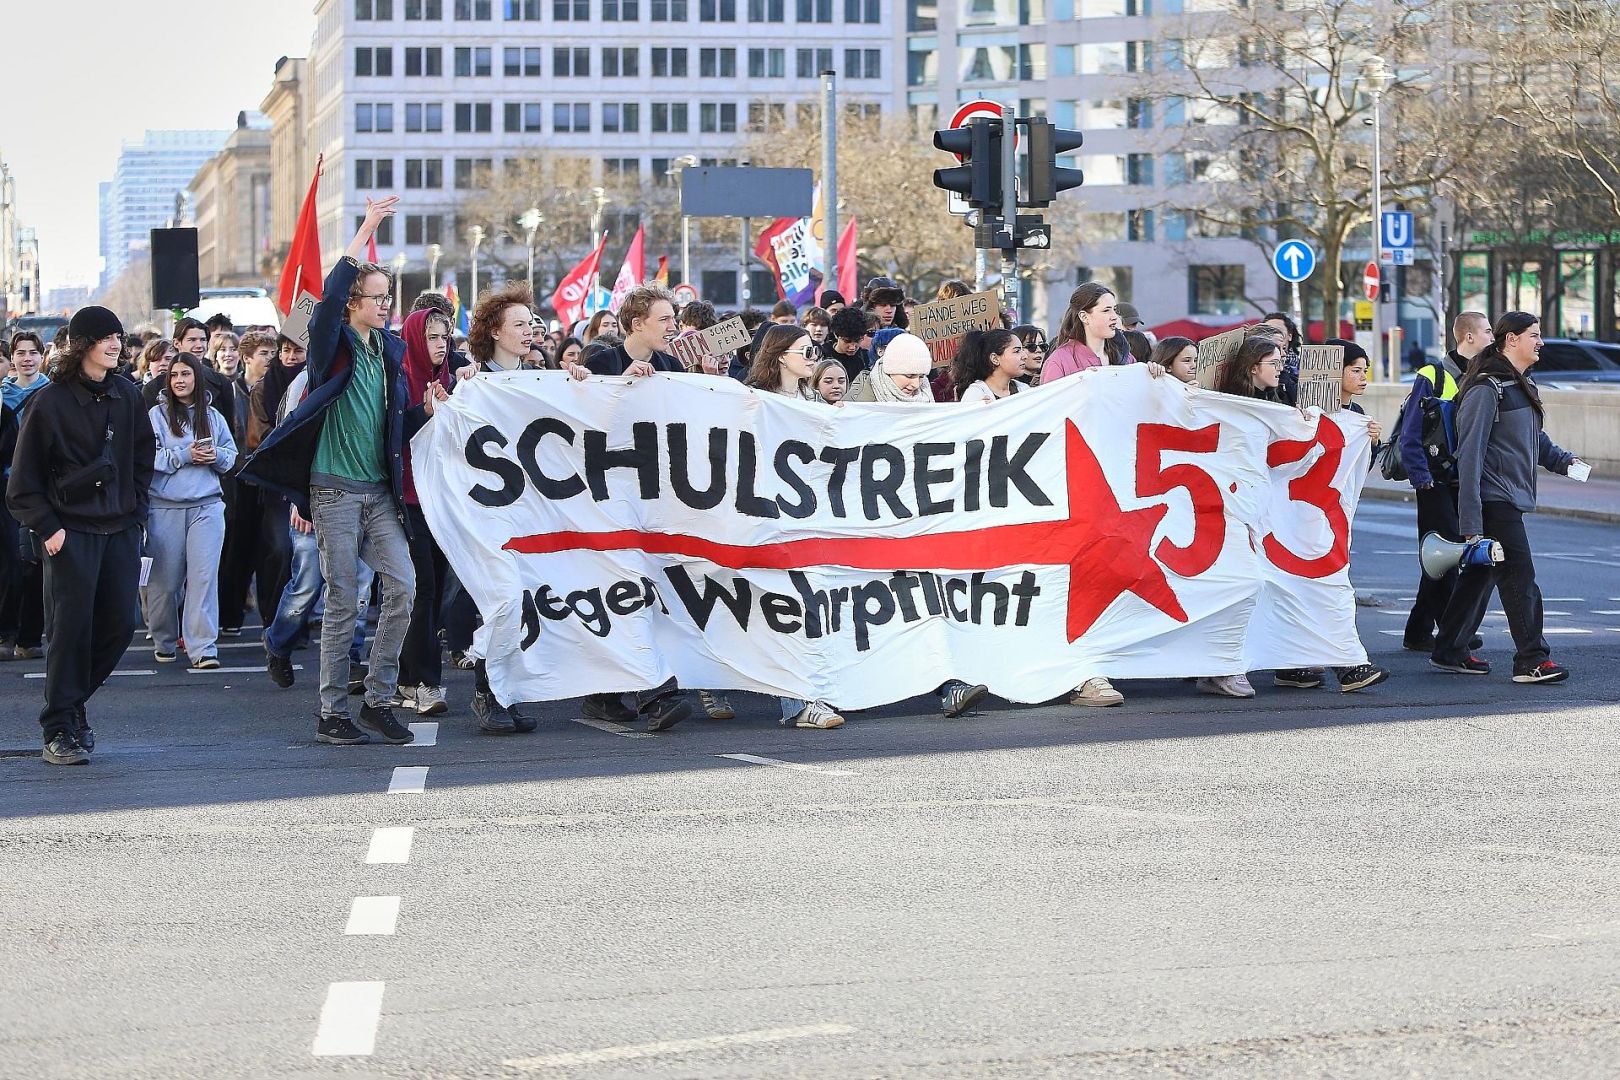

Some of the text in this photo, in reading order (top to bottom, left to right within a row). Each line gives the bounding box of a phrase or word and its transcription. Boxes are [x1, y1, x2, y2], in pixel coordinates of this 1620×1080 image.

[1386, 214, 1408, 247] U
[918, 303, 957, 325] HÄNDE
[960, 297, 988, 317] WEG
[920, 327, 938, 341] VON
[941, 318, 976, 338] UNSERER
[464, 416, 1054, 521] SCHULSTREIK
